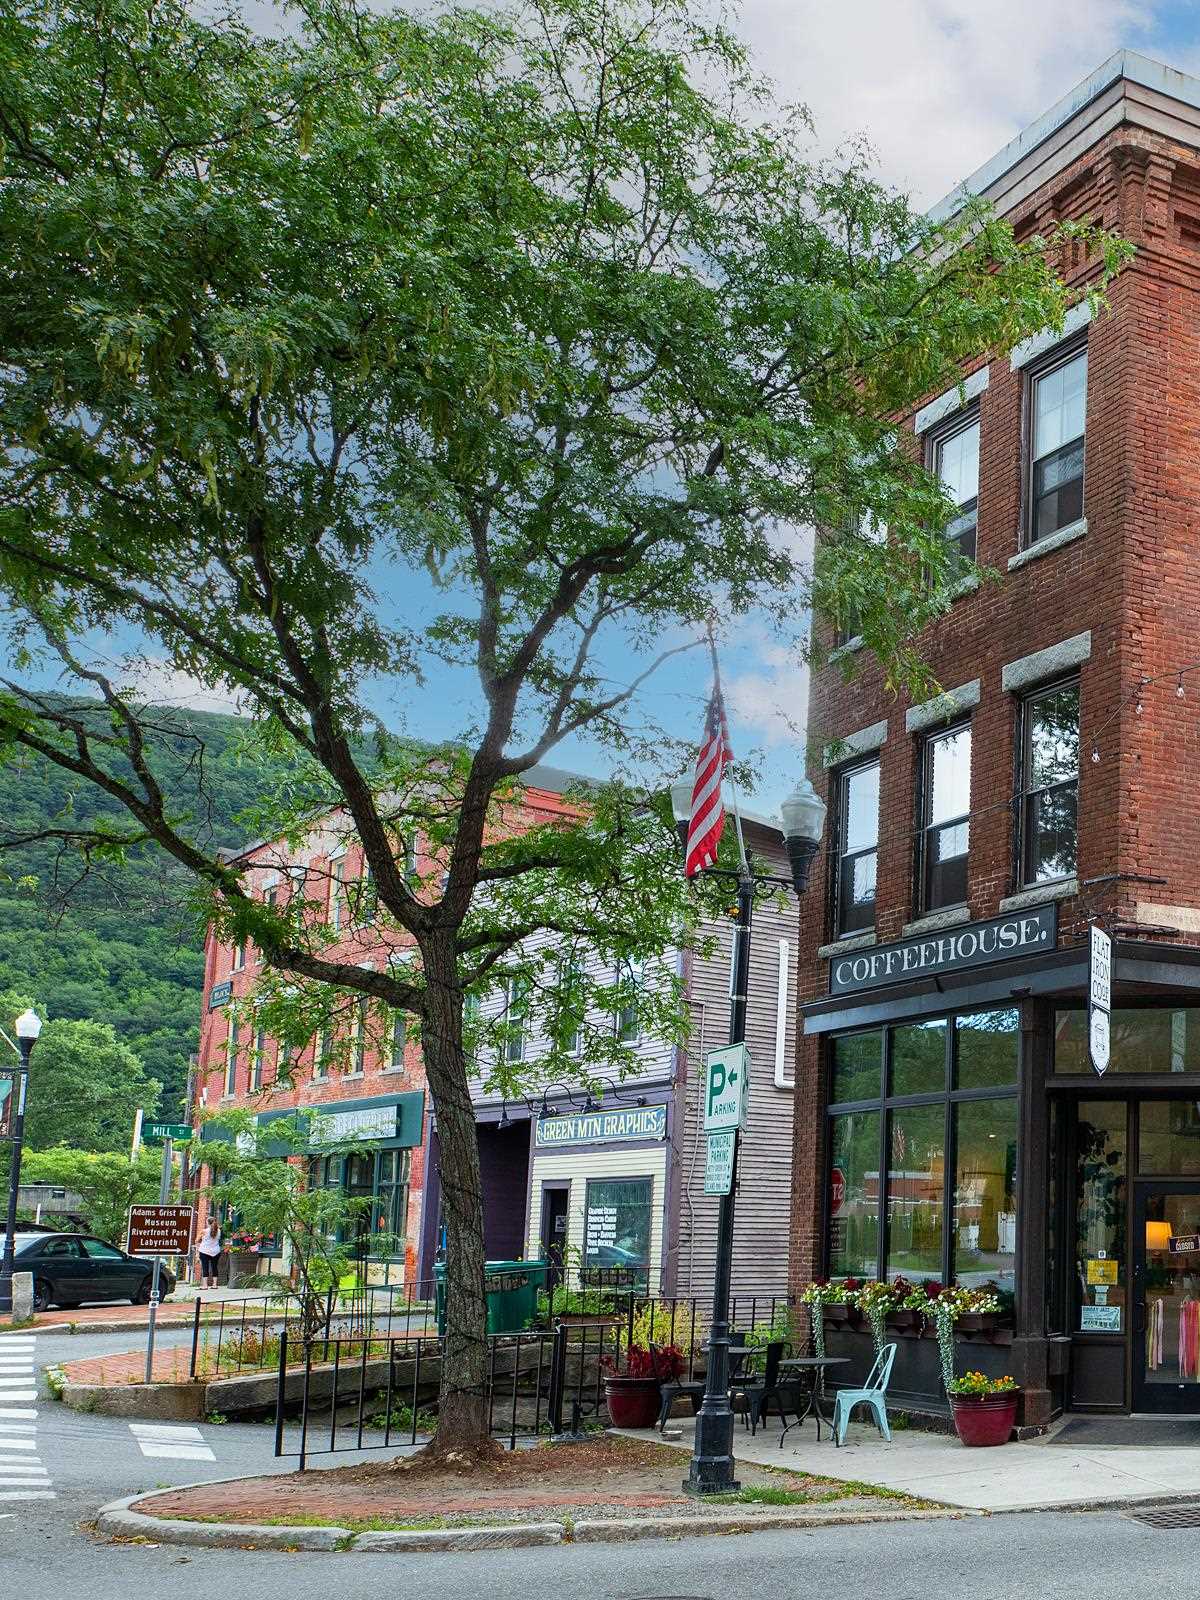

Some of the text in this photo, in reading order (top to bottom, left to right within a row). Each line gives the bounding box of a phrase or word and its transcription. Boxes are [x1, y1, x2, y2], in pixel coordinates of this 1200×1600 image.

[835, 916, 1047, 985] COFFEEHOUSE.
[1093, 934, 1109, 960] FLAT
[1093, 956, 1110, 980] IRON
[544, 1111, 657, 1140] GREEN MTN GRAPHICS
[152, 1126, 171, 1136] MILL
[132, 1208, 156, 1216] Adams
[145, 1218, 177, 1226] Museum
[132, 1228, 188, 1236] Riverfront Park
[140, 1239, 178, 1247] Labyrinth
